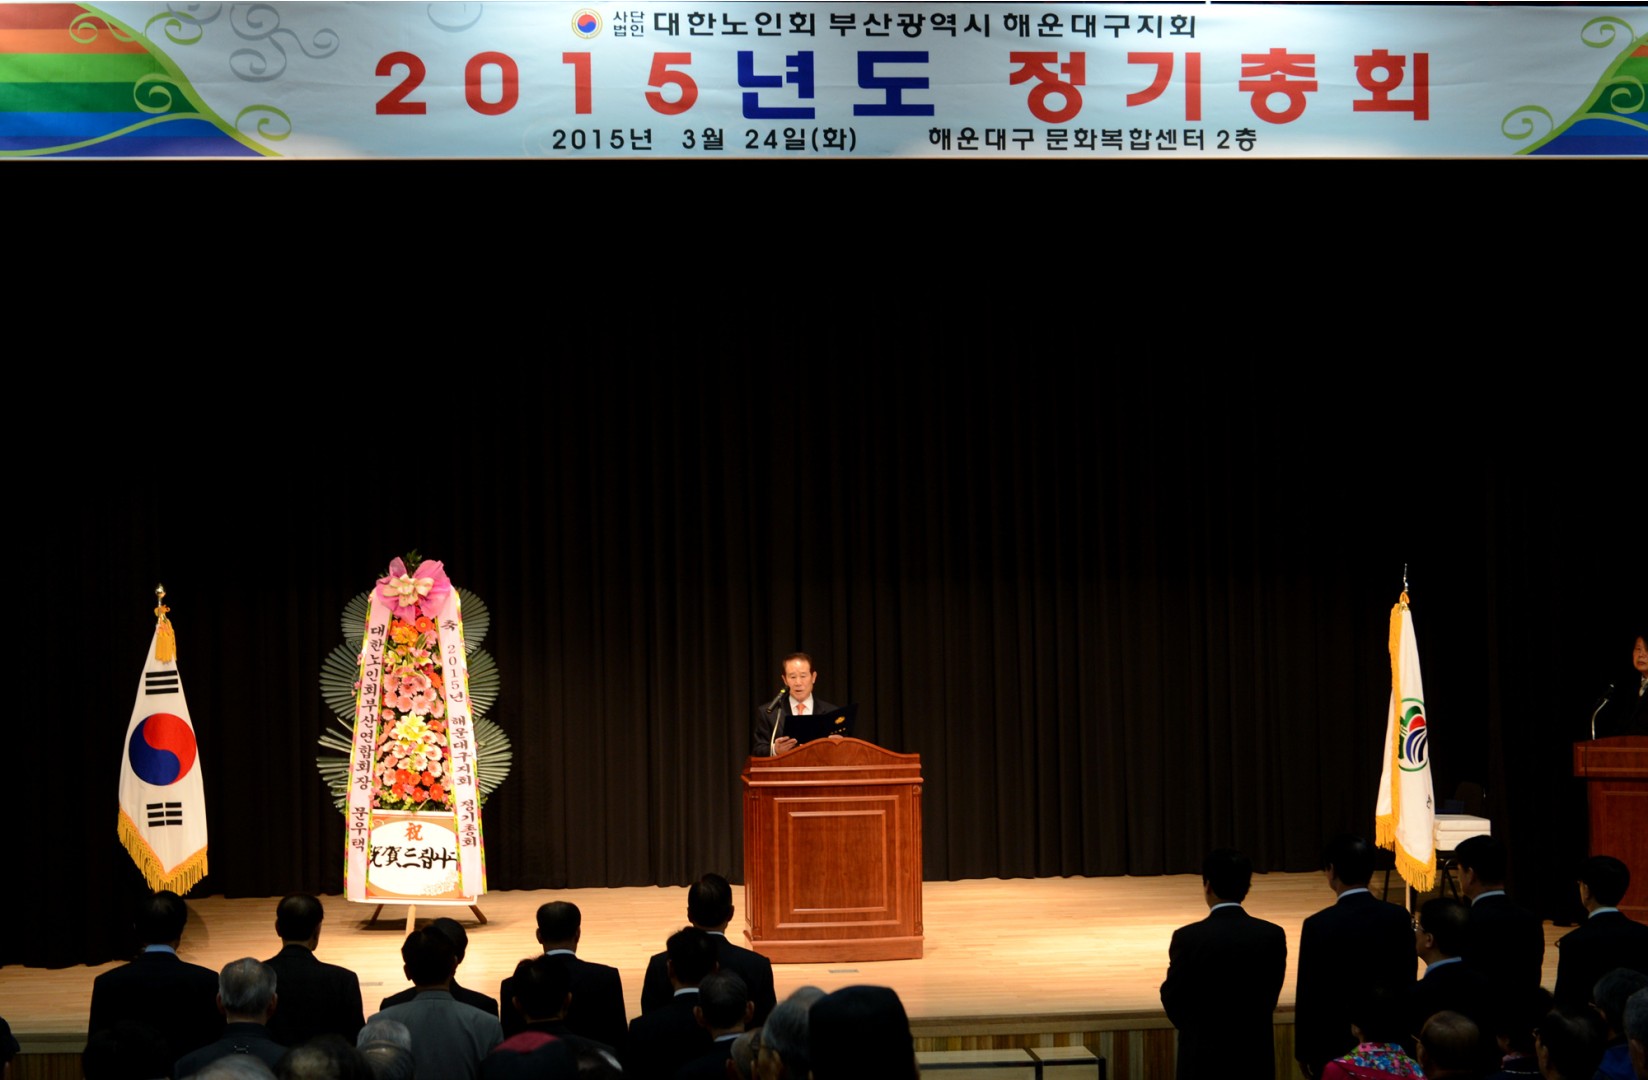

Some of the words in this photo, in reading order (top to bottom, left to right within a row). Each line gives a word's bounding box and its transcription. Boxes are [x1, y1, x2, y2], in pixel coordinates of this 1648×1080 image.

[613, 11, 645, 24] 사단
[613, 24, 645, 38] 법인
[654, 11, 816, 37] 대한노인회
[828, 12, 990, 38] 부산광역시
[1003, 12, 1195, 38] 해운대구지회
[1009, 48, 1429, 124] 정기총회
[552, 128, 653, 151] 2015년
[682, 127, 724, 151] 3월
[745, 127, 857, 152] 24일(화)
[928, 127, 1035, 151] 해운대구
[1046, 127, 1204, 151] 문화복합센터
[1216, 127, 1257, 151] 2층
[448, 645, 463, 703] 2015년
[451, 715, 472, 786] 해운대구지회
[404, 822, 423, 841] 祝
[460, 799, 477, 847] 정기총회
